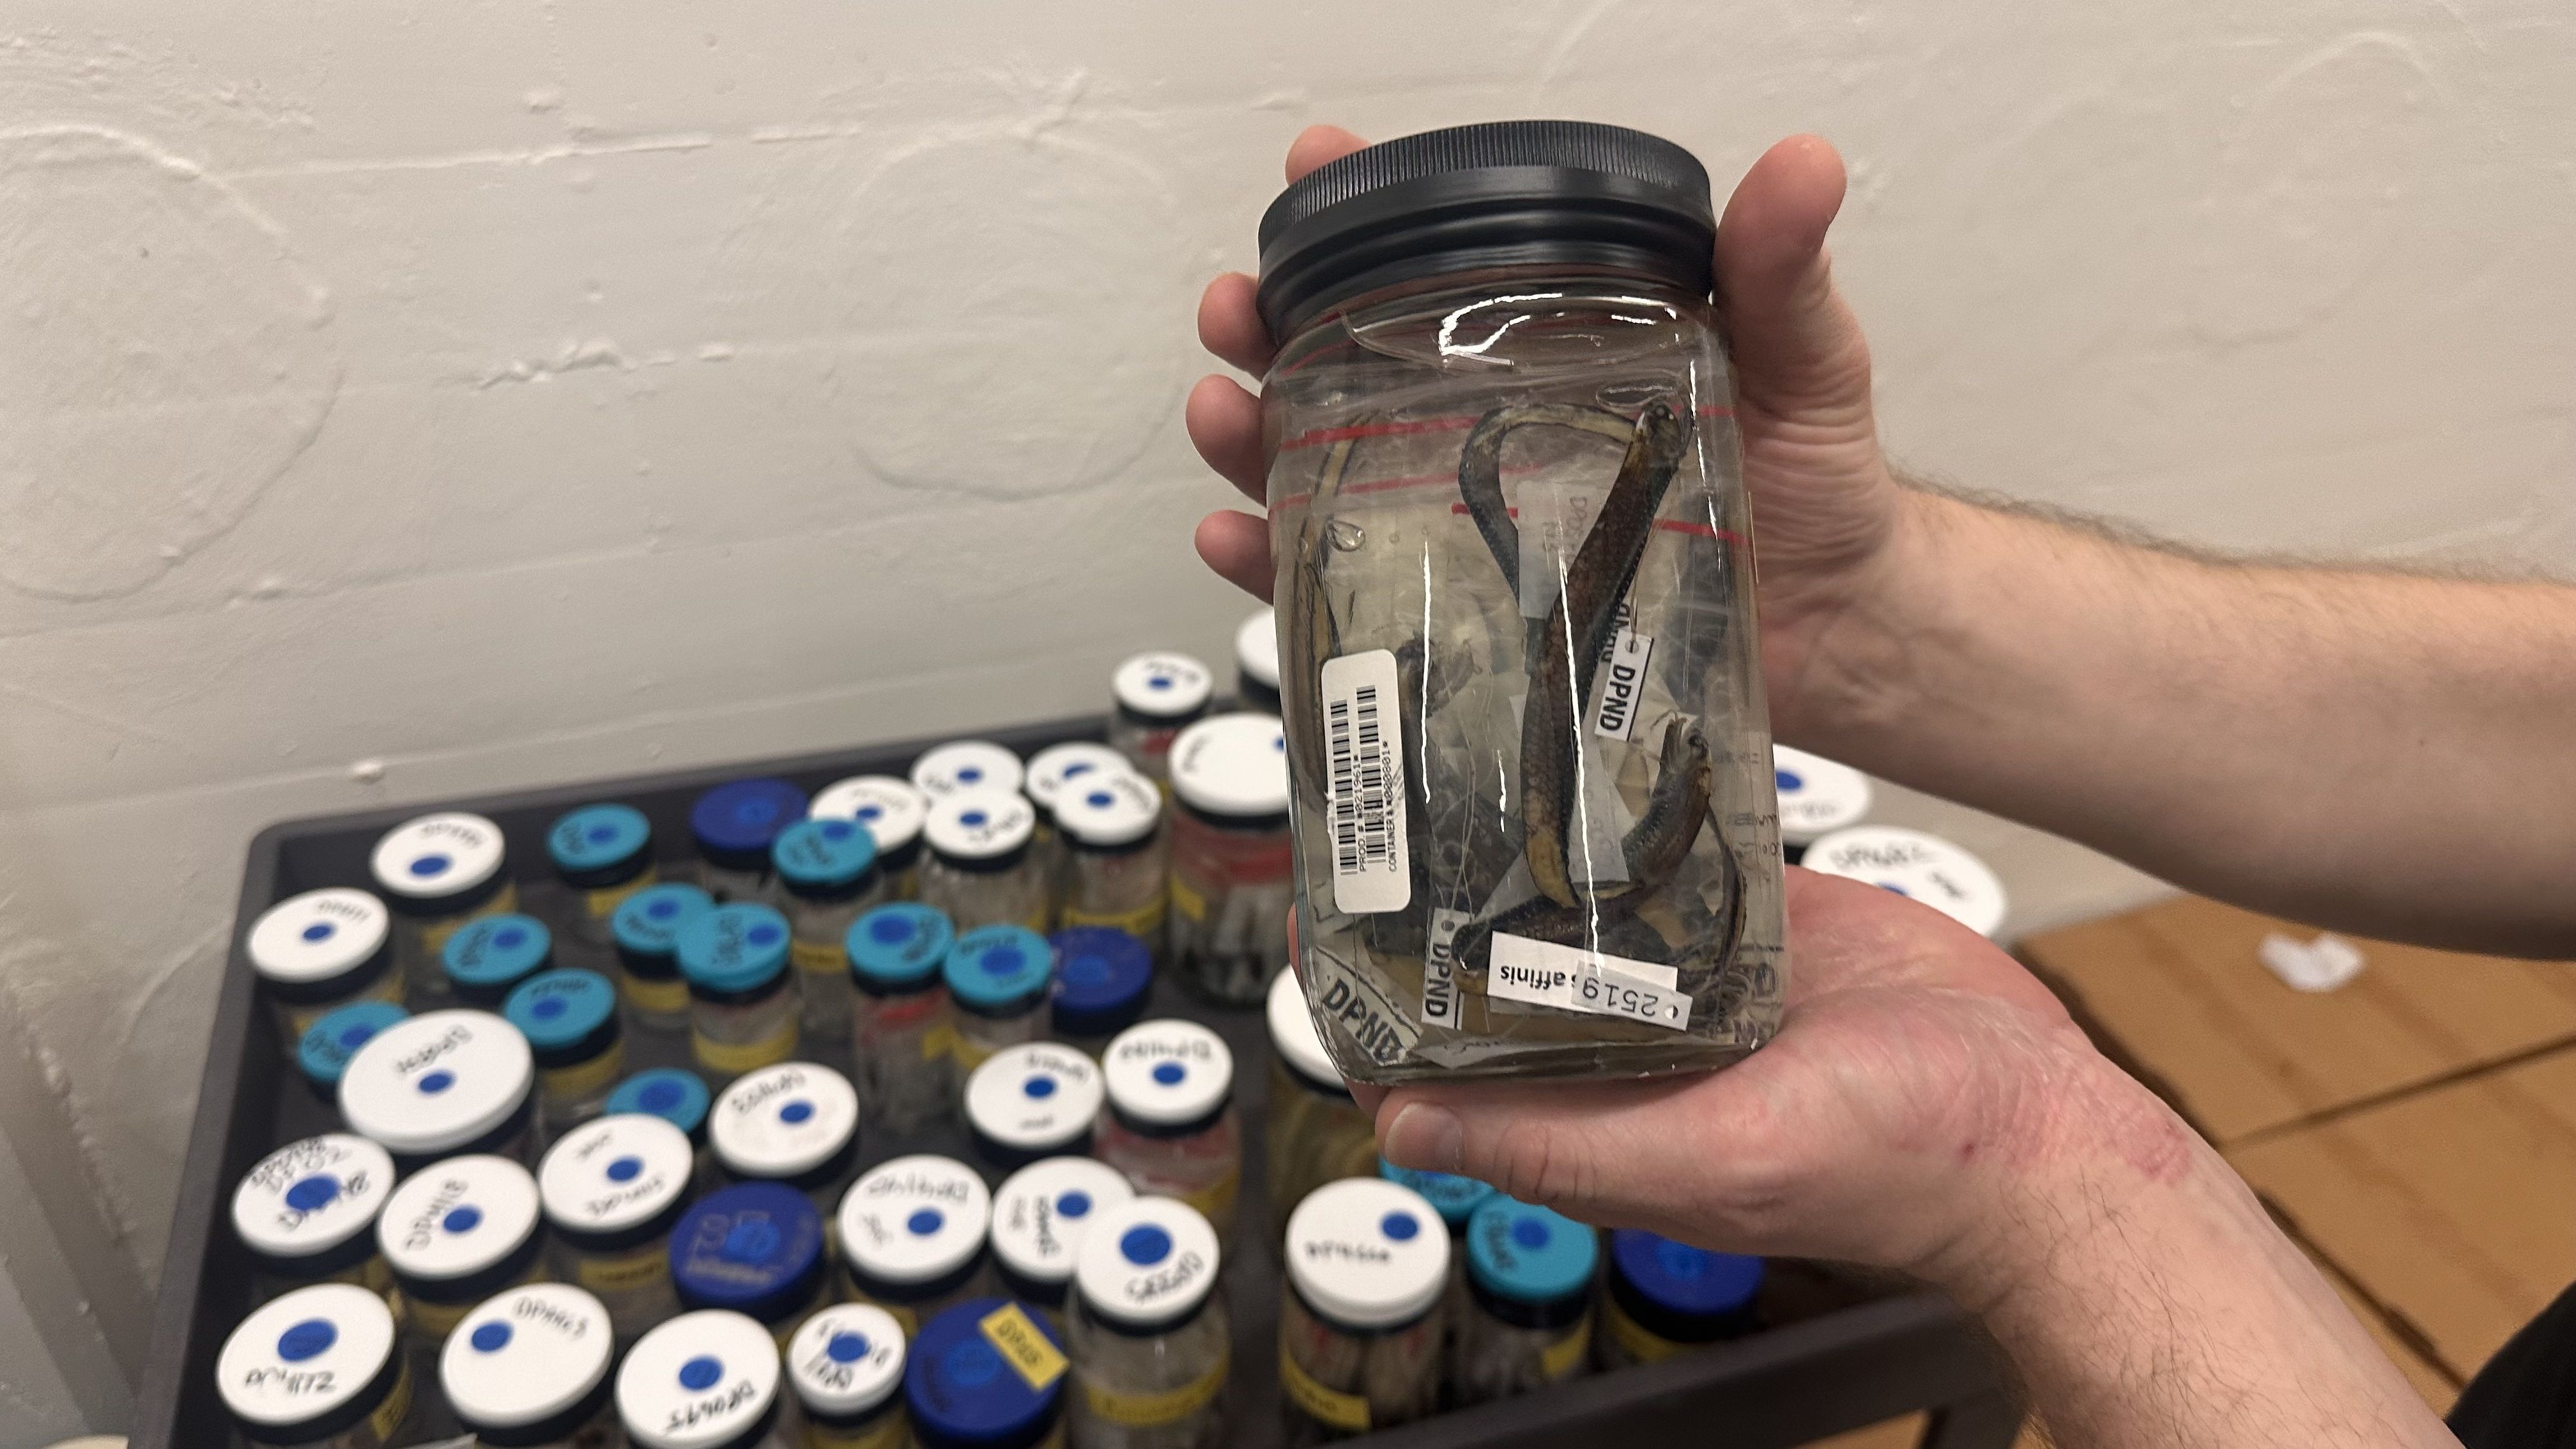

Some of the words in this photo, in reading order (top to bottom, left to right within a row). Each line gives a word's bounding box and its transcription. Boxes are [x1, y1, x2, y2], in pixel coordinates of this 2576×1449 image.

[1600, 664, 1636, 730] DPND
[1425, 943, 1452, 1016] DPND
[1500, 965, 1566, 990] affinis
[1583, 976, 1659, 1016] 2519
